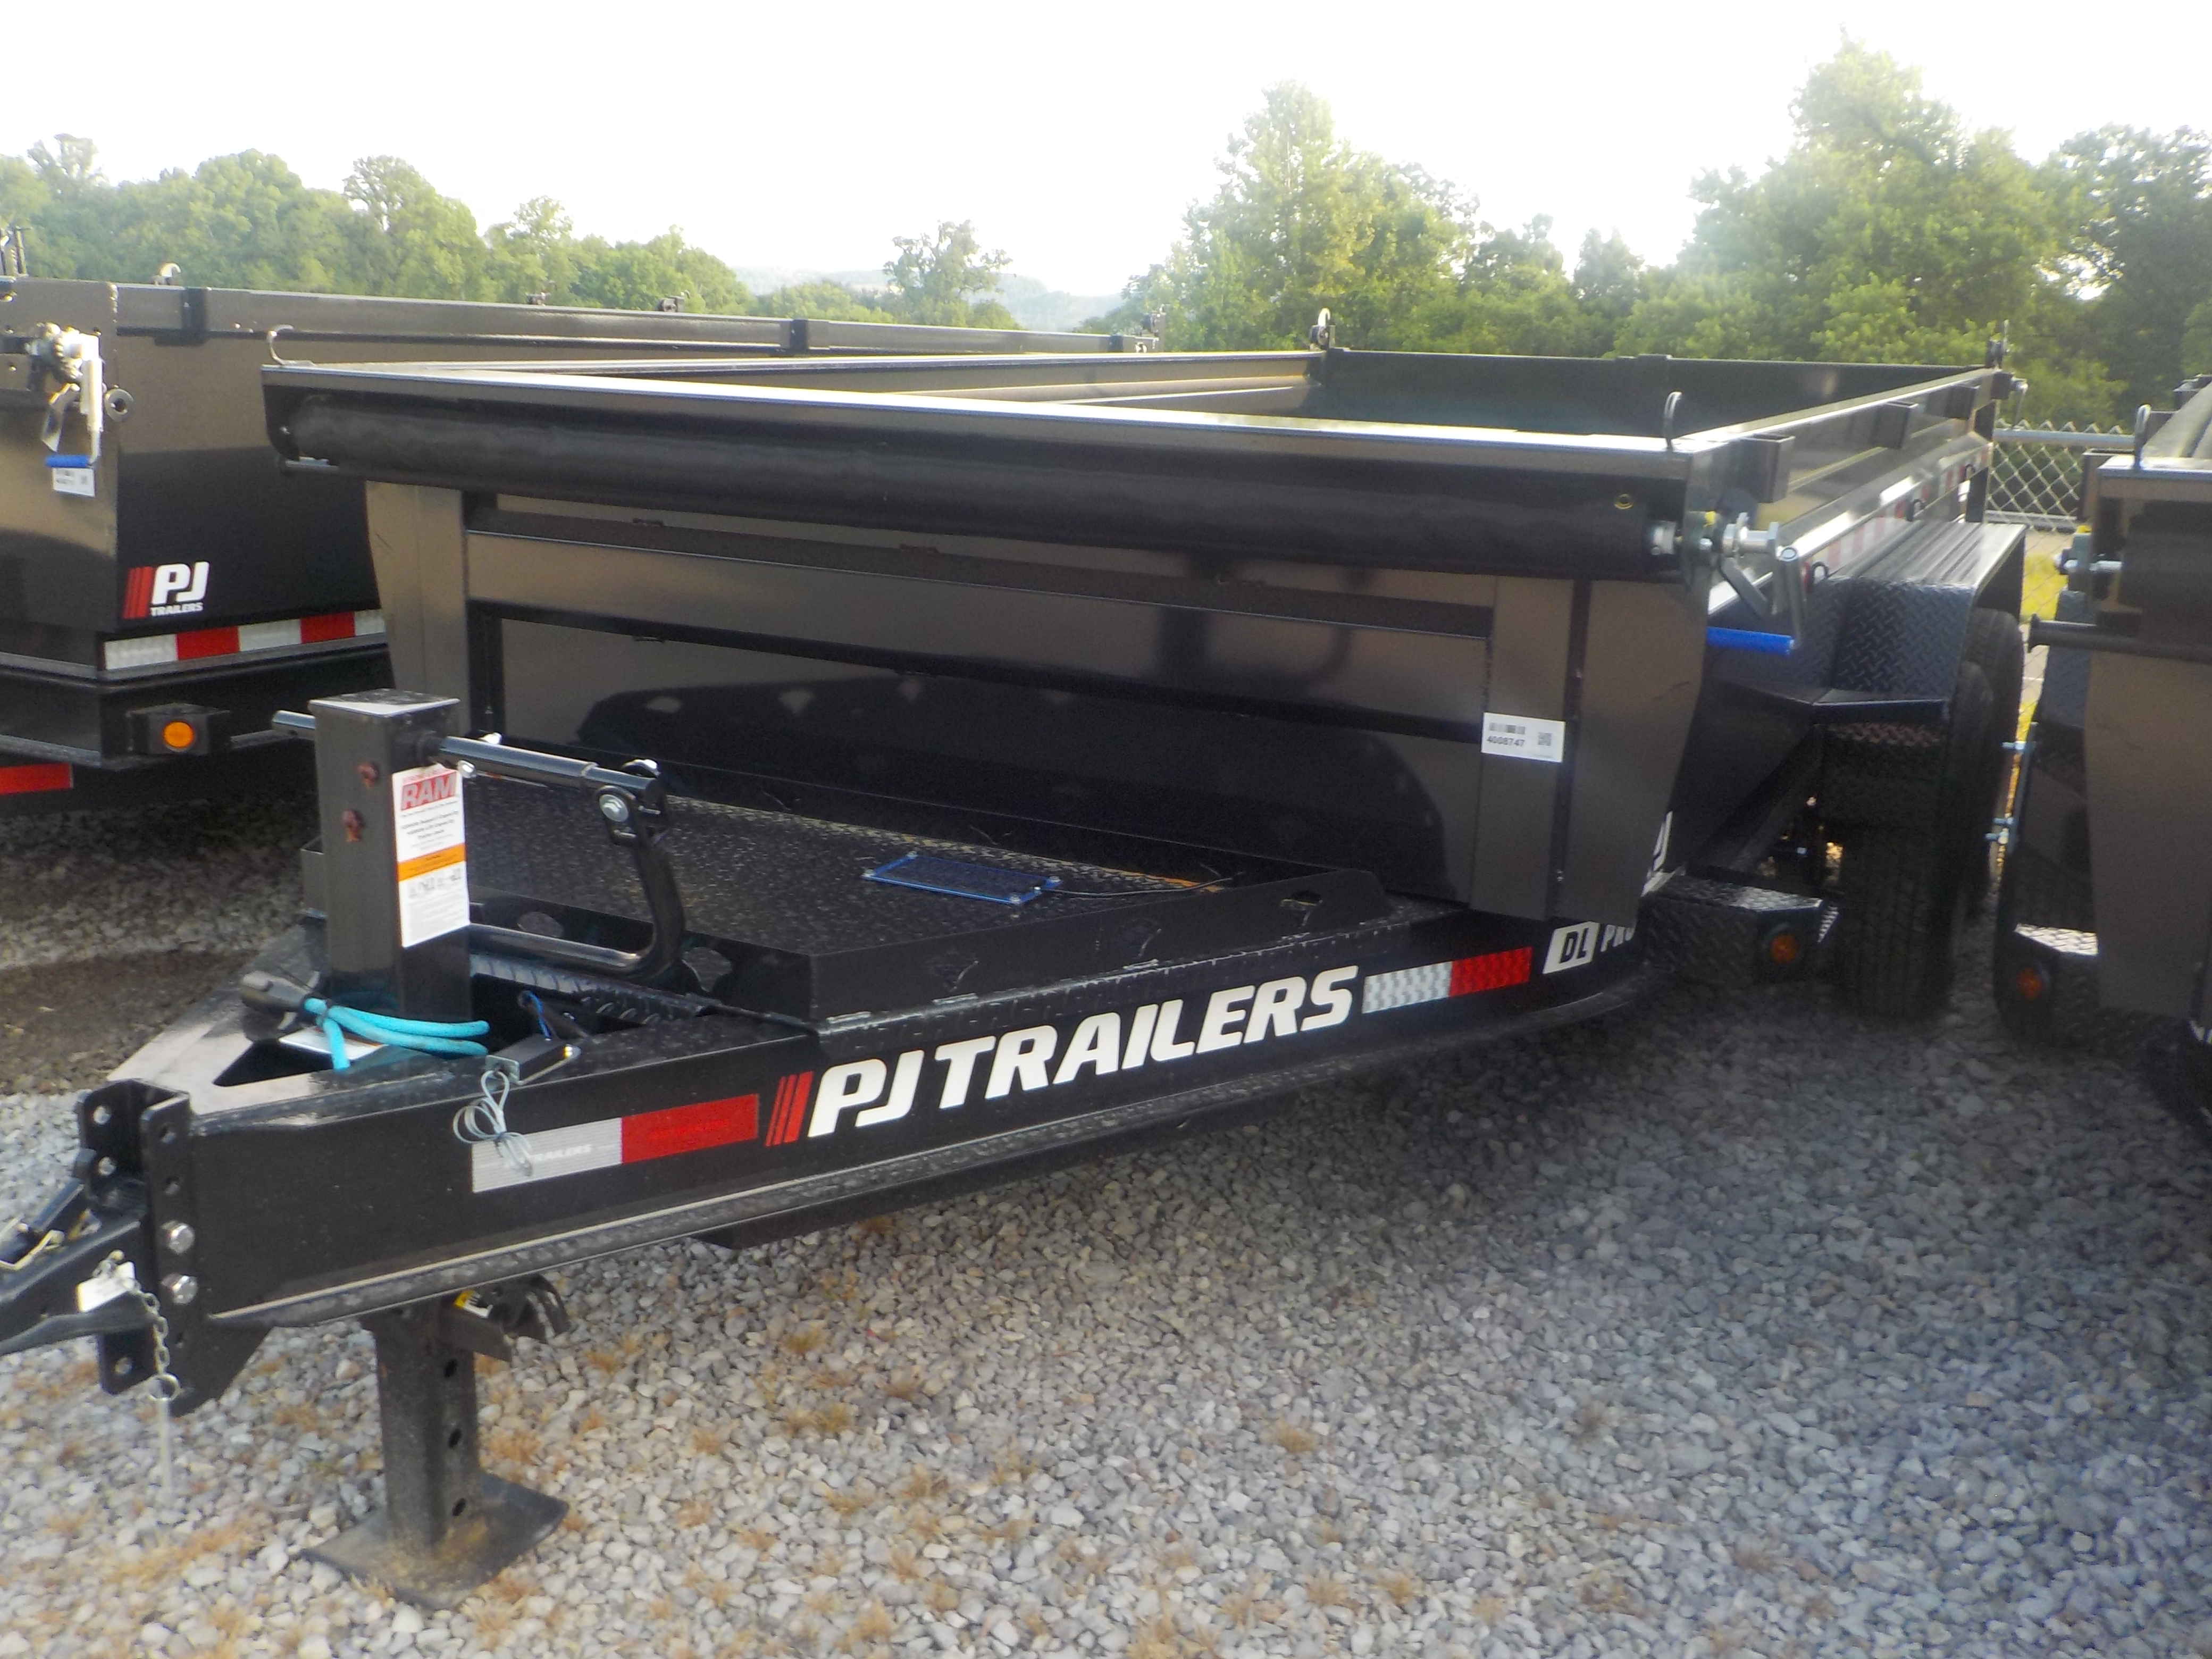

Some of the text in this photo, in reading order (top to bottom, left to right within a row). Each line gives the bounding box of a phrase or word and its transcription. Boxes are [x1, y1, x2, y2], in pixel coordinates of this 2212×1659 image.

[152, 561, 210, 605] PJ
[150, 602, 204, 617] TRAILERS
[402, 772, 457, 810] RAM
[1559, 927, 1590, 963] DL
[807, 966, 1359, 1138] PJ TRAILERS
